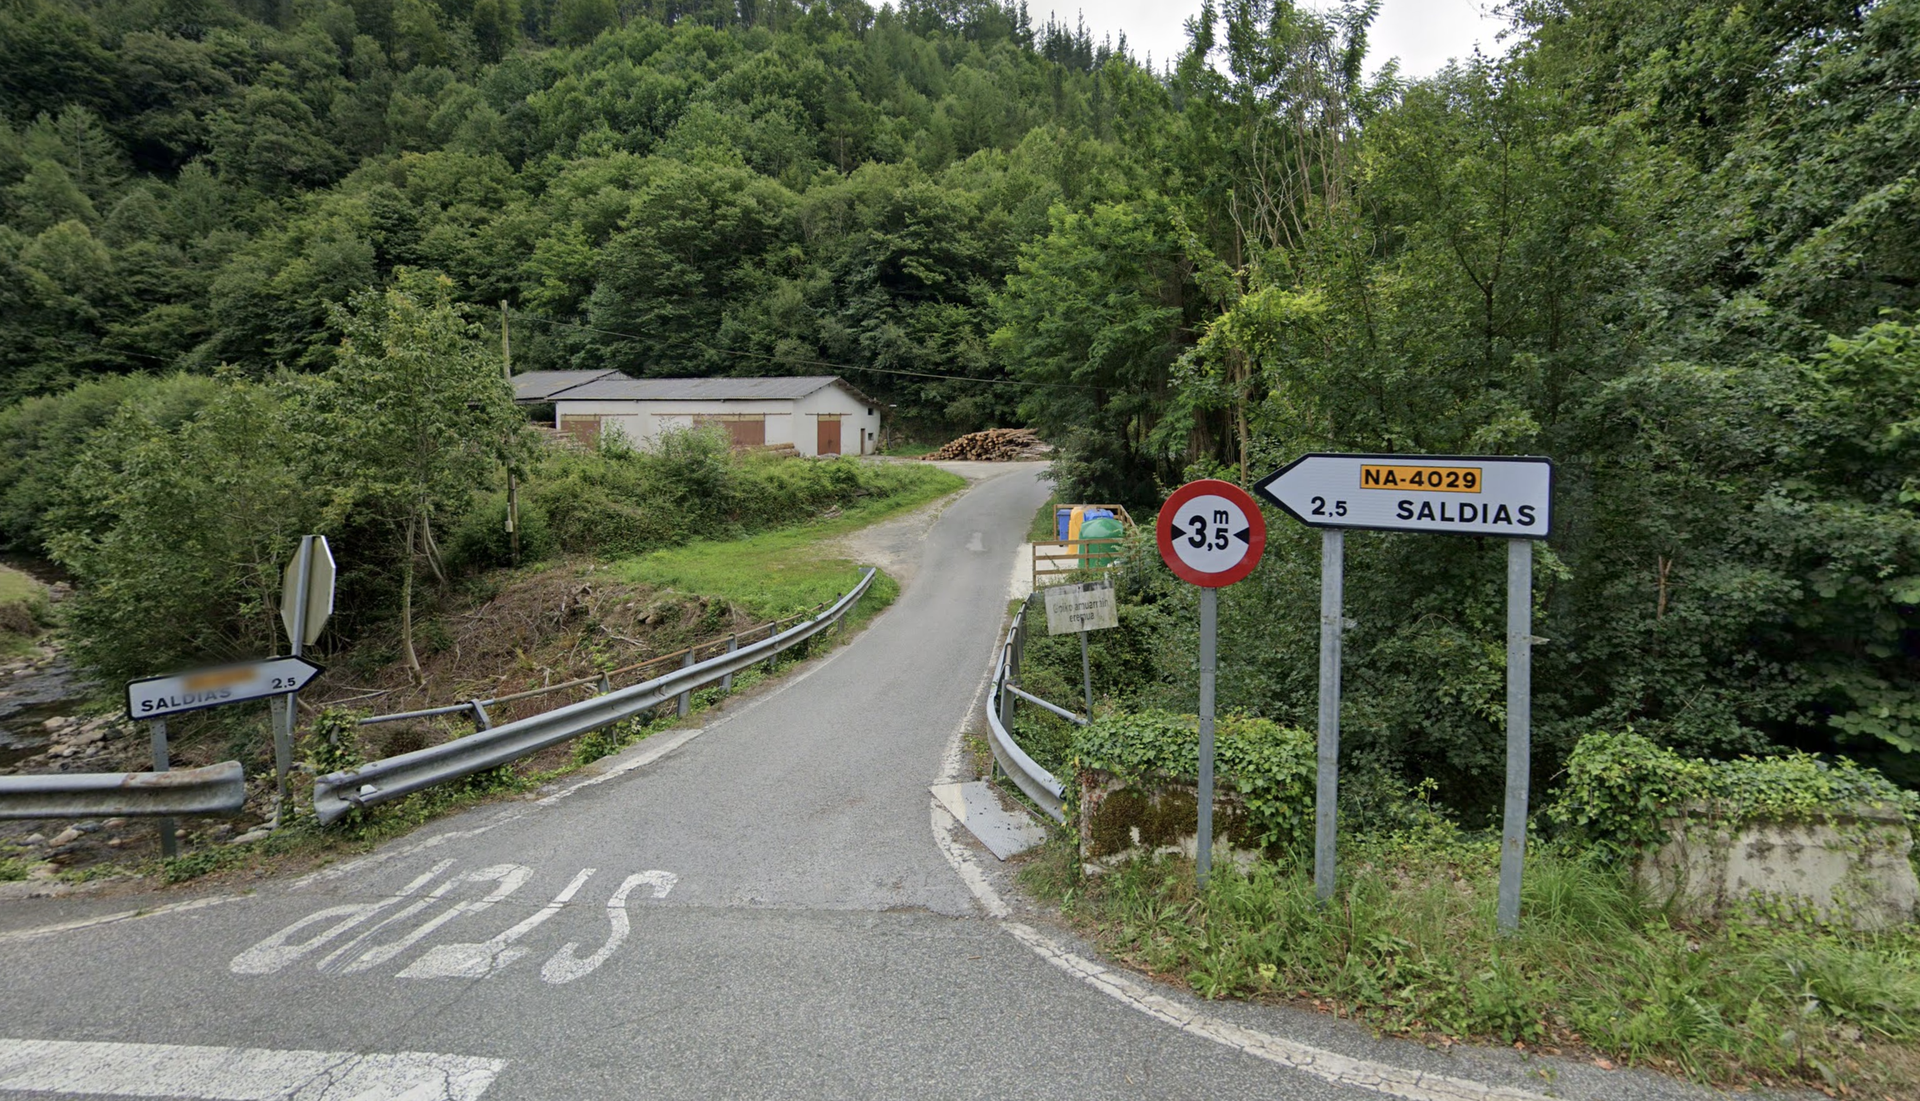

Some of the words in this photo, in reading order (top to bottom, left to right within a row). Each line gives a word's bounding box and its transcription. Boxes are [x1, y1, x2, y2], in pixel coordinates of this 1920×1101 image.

[1363, 467, 1478, 489] NA-4029
[1213, 509, 1230, 525] m
[1310, 496, 1348, 518] 2,5
[1396, 499, 1537, 526] SALDIAS
[1188, 515, 1229, 552] 3,5
[141, 688, 232, 712] SALDIAS
[229, 858, 677, 985] STOP
